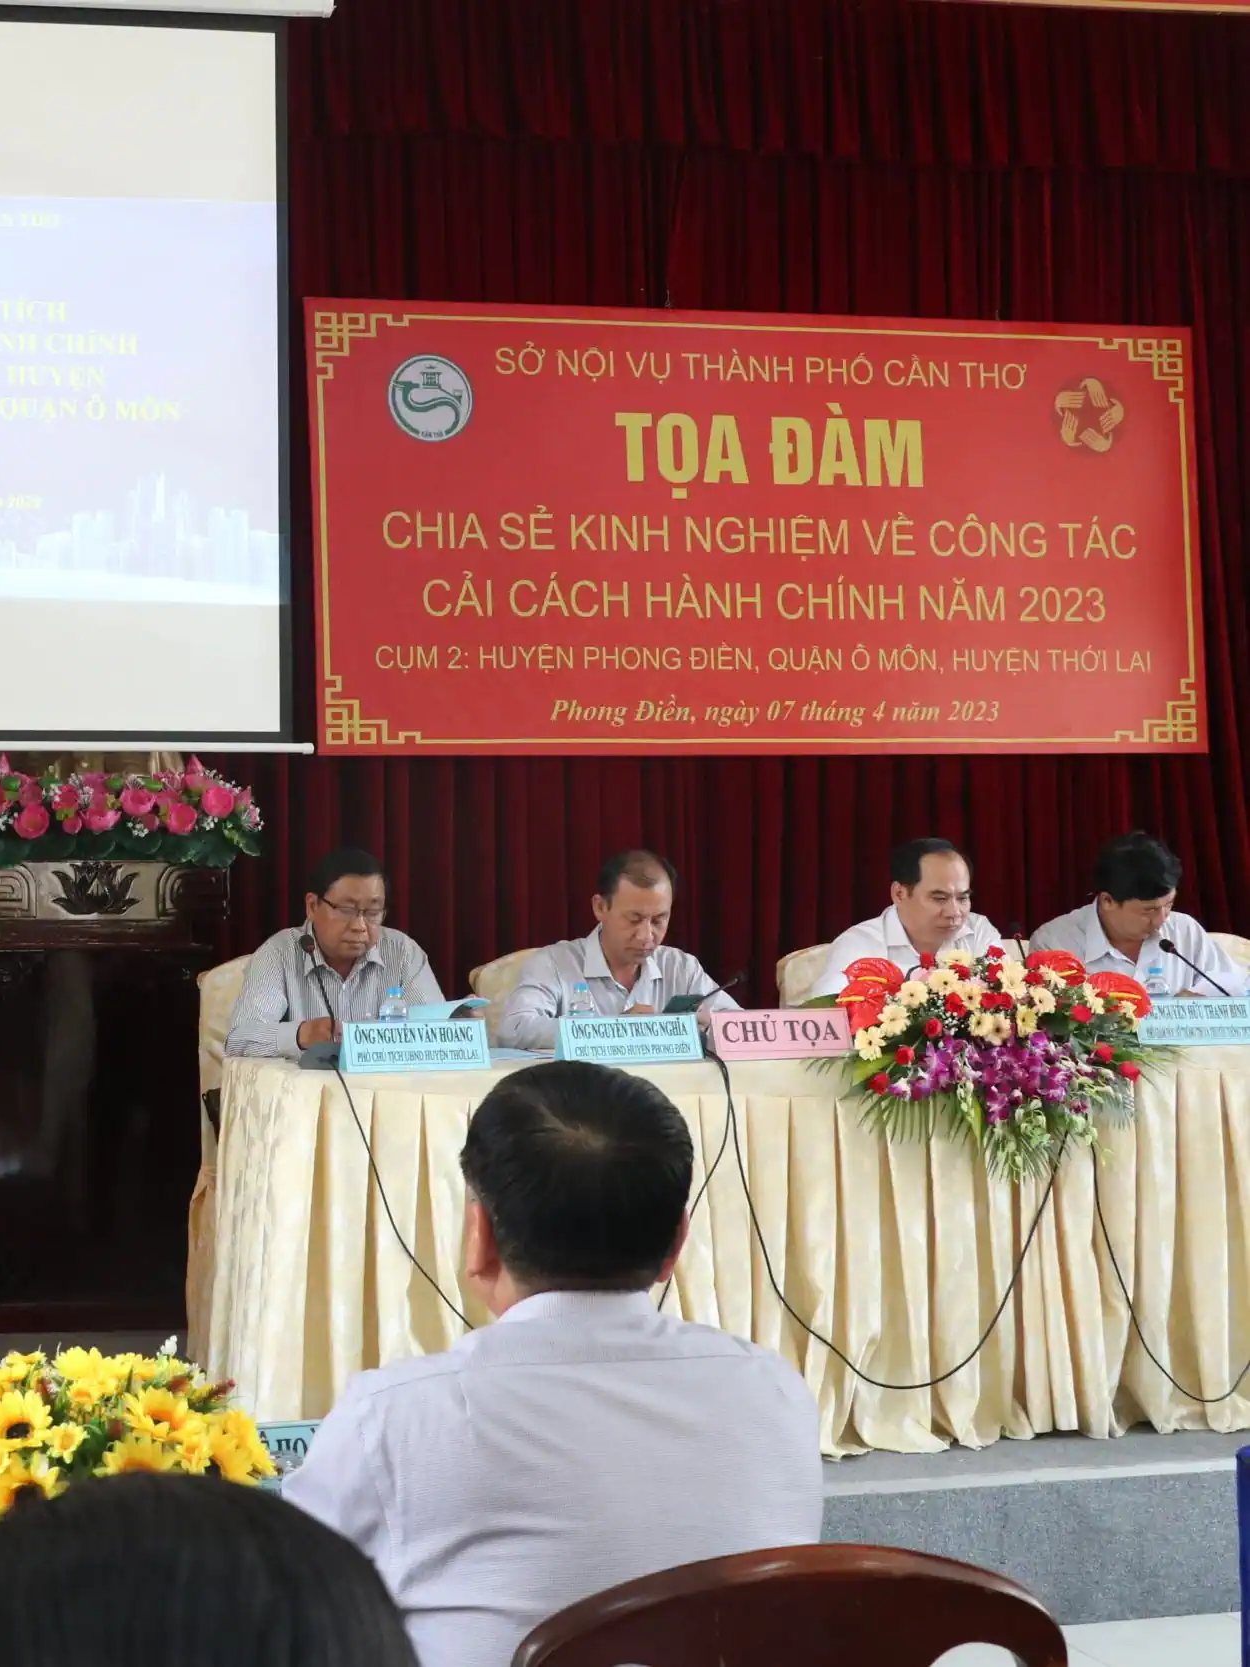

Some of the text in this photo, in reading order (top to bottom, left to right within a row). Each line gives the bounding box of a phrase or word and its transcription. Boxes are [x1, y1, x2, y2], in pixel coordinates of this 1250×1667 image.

[495, 341, 1027, 389] SỞ NỘI VỤ THÀNH PHỐ CẦN THƠ
[614, 402, 924, 499] TỌA ĐÀM
[381, 504, 1138, 562] CHIA SẺ KINH NGHIỆM VỀ CÔNG TÁC
[422, 569, 1108, 623] CẢI CÁCH HÀNH CHÍNH NĂM 2023
[374, 641, 1152, 676] CỤM 2: HUYỆN PHONG ĐIỀN, QUẬN Ô MÔN, HUYỆN THỚI LAI
[550, 694, 1001, 728] Phong Điền, ngày 07 tháng 4 năm 2023
[354, 1023, 474, 1044] ÔNG NGUYỄN VĂN HOÀNG
[571, 1017, 689, 1040] ÔNG NGUYỄN TRUNG NGHĨA
[721, 1013, 842, 1048] CHỦ TỌA
